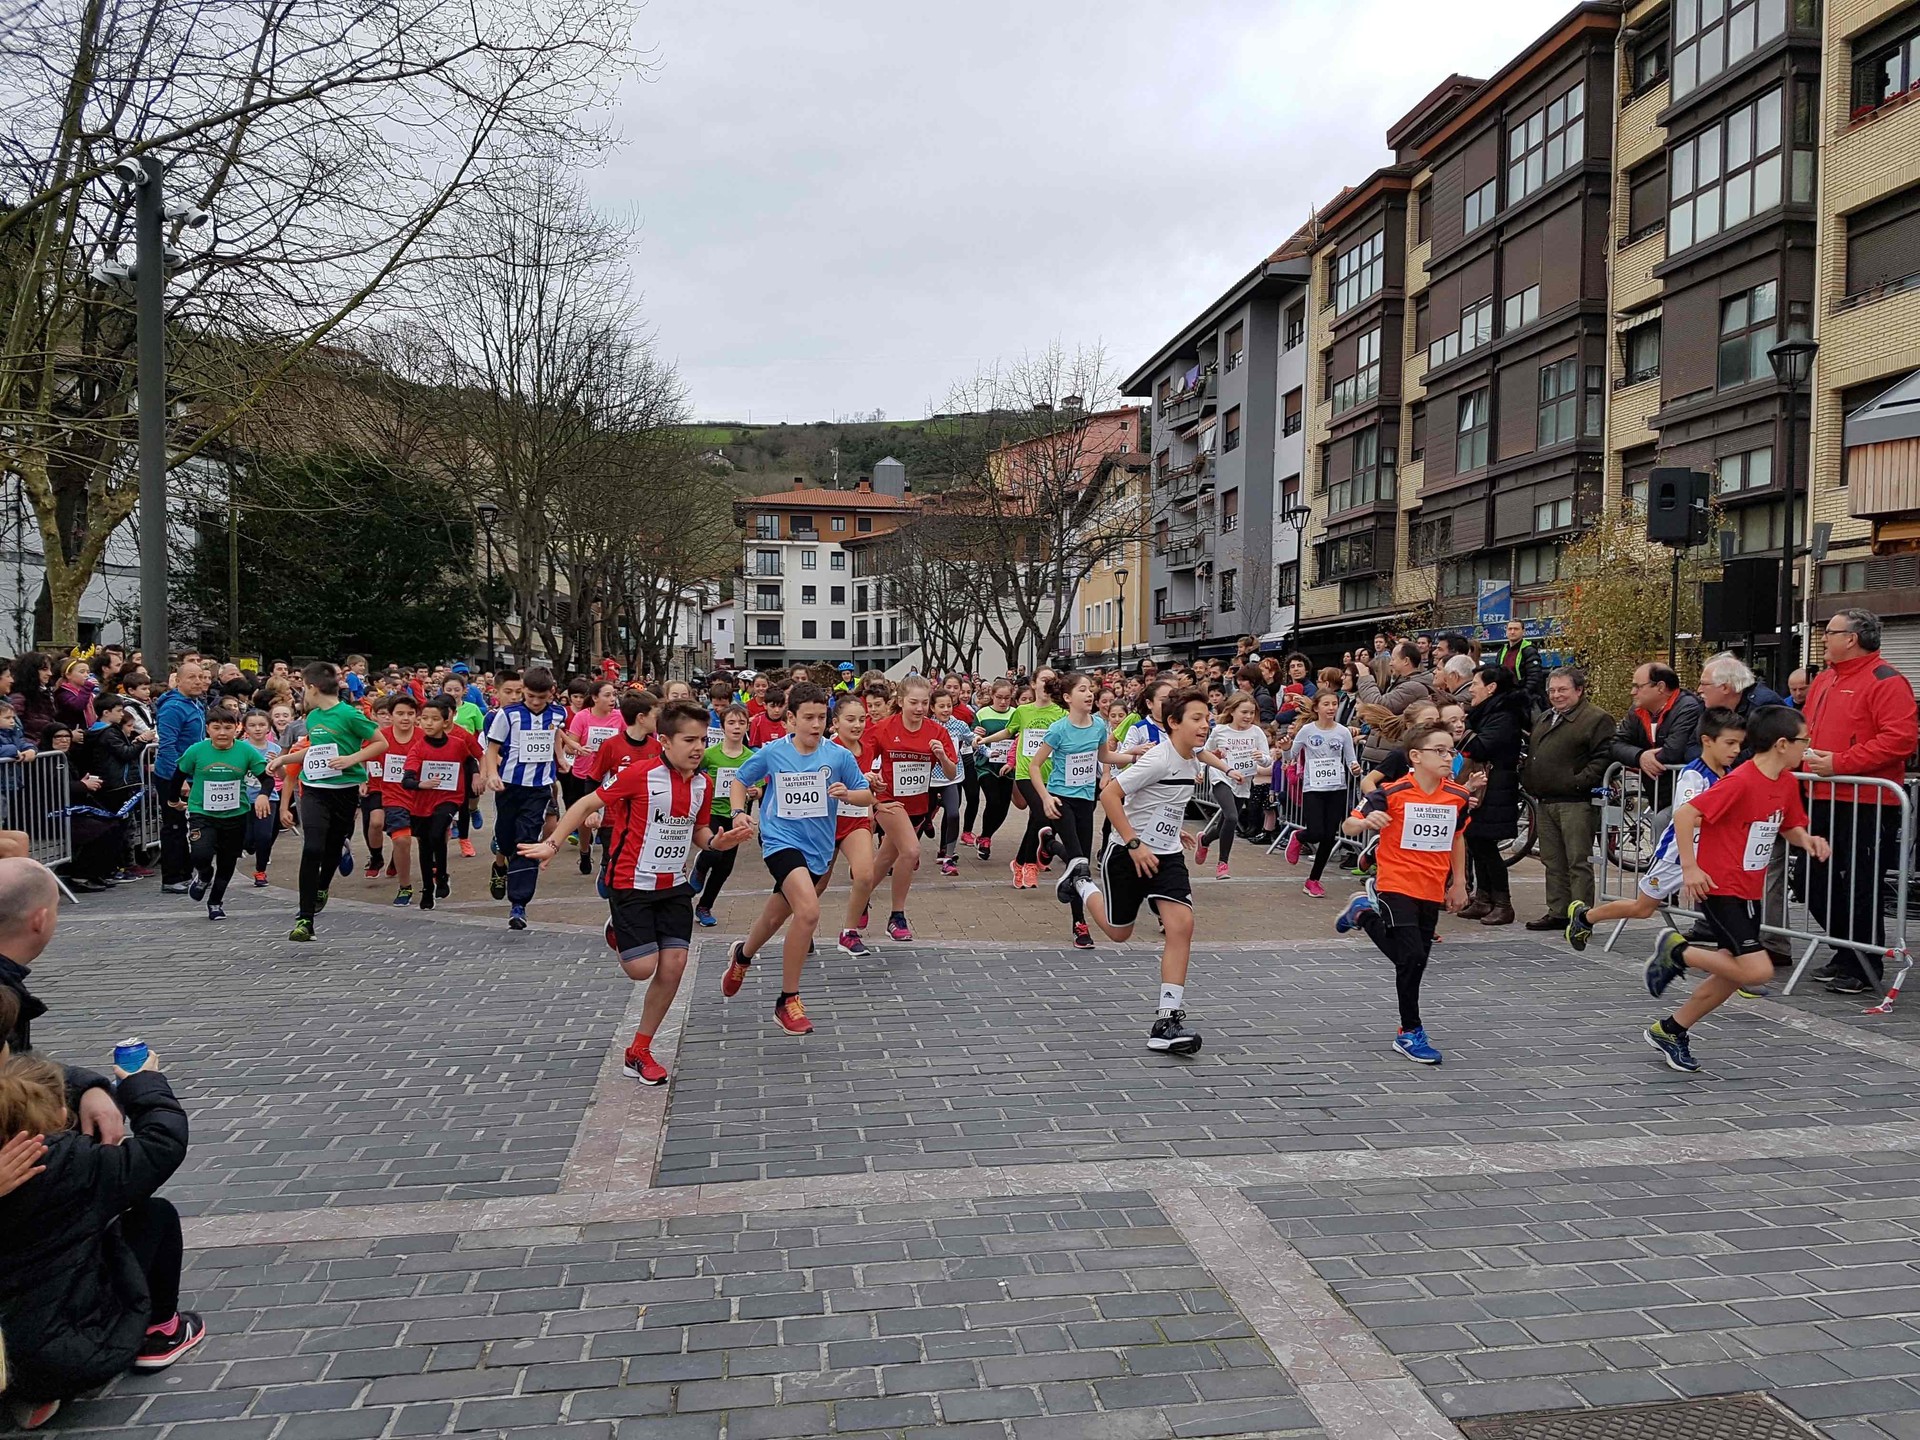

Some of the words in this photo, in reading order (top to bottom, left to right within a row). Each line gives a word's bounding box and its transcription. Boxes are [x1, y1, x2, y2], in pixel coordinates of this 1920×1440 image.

[1227, 738, 1255, 746] SUNSET
[526, 743, 551, 753] 0959
[308, 759, 330, 770] 093
[1234, 760, 1254, 770] 0963
[1072, 764, 1094, 776] 0946
[1315, 769, 1337, 778] 0964
[427, 772, 453, 781] 022
[900, 775, 925, 786] 0990
[210, 792, 235, 802] 0931
[785, 791, 819, 805] 0940
[1413, 823, 1448, 837] 0934
[654, 845, 686, 859] 0939
